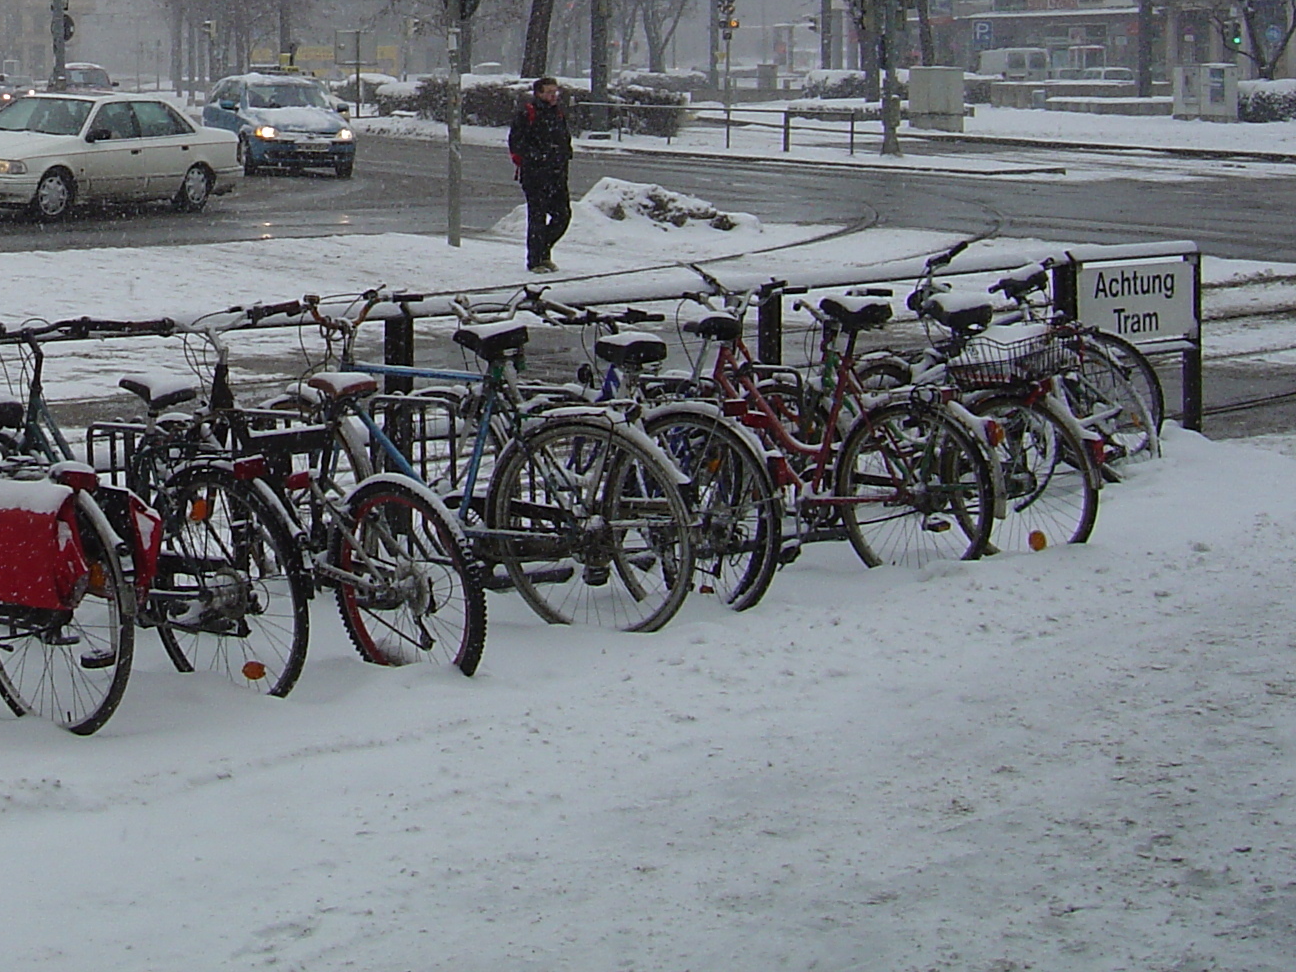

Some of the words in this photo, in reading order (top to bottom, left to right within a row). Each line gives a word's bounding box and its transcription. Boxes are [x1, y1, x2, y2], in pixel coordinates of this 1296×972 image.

[975, 22, 990, 40] P
[1094, 270, 1175, 299] Achtung
[1113, 308, 1159, 335] Tram
